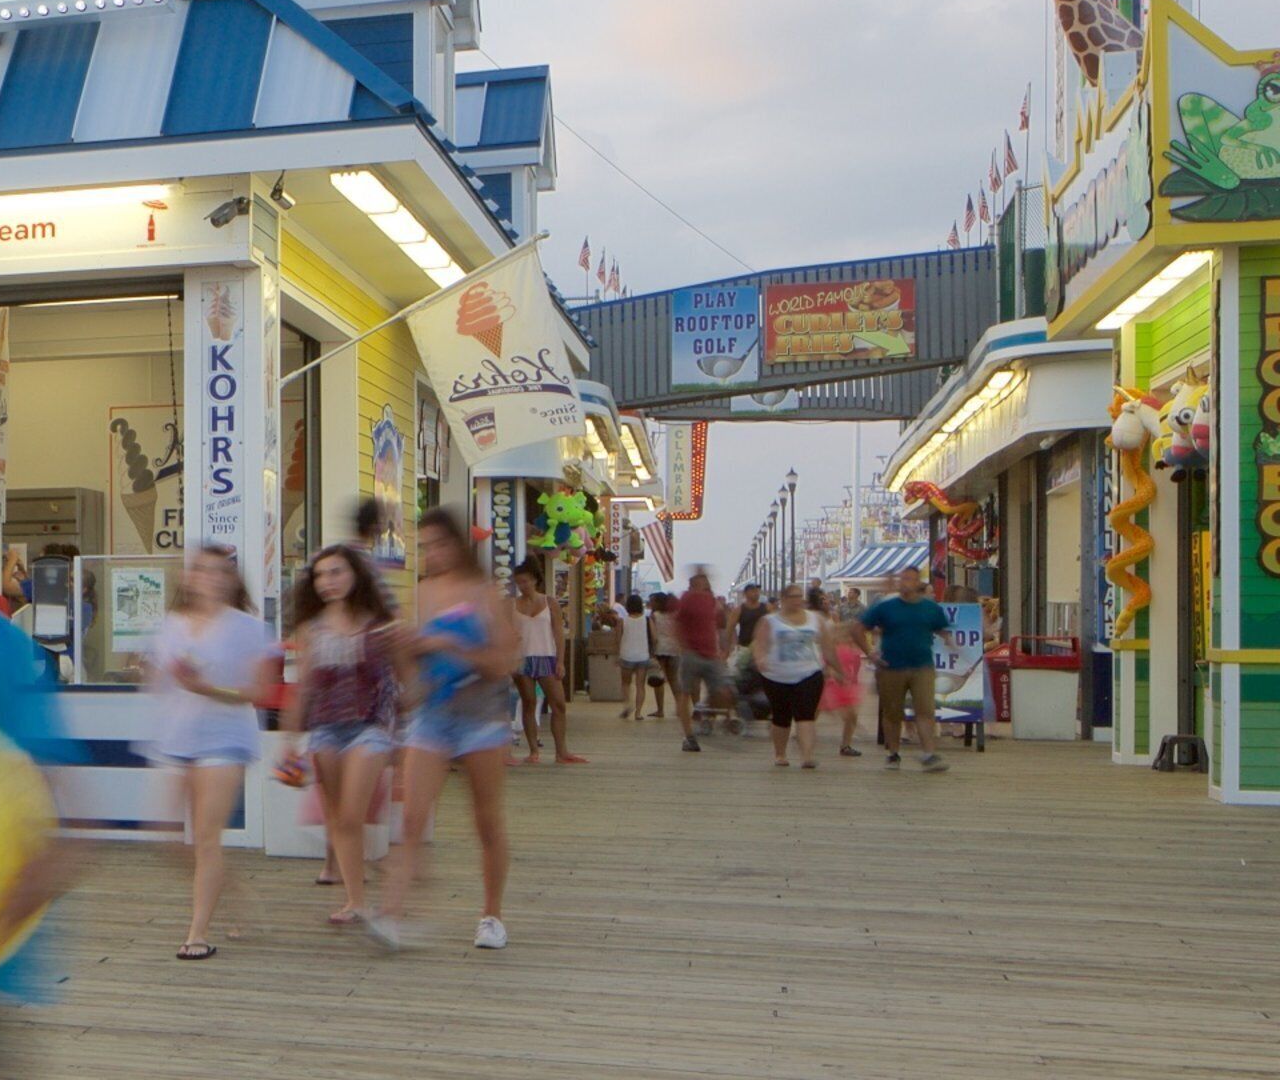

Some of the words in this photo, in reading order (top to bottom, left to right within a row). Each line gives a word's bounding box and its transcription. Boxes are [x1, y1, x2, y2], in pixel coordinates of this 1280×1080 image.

[693, 291, 737, 309] PLAY
[768, 296, 815, 316] WORLD
[674, 313, 756, 333] ROOFTOP
[693, 337, 737, 355] GOLF
[775, 333, 855, 356] FRIES
[208, 513, 239, 524] Since
[612, 504, 620, 533] CORN
[211, 524, 236, 535] 1919
[935, 653, 960, 670] LF
